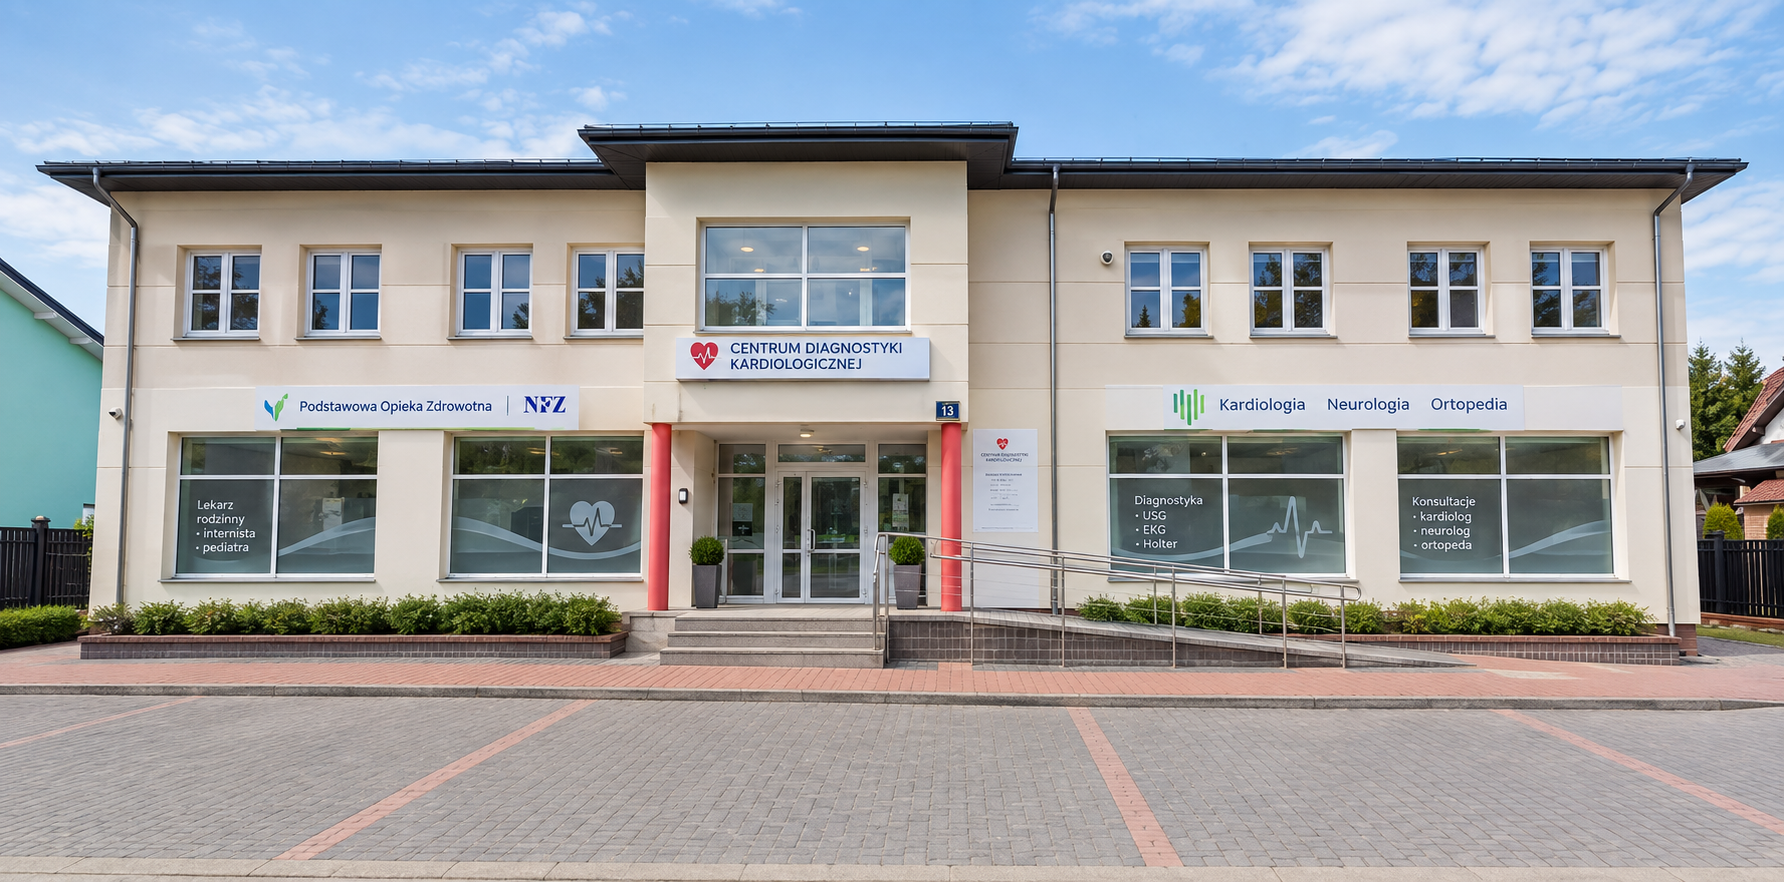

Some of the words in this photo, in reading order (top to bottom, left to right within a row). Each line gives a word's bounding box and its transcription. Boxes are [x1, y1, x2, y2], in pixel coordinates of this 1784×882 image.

[731, 342, 801, 354] CENTRUM
[806, 343, 901, 354] DIAGNOSTYKI
[731, 358, 862, 370] KARDIOLOGICZNEJ
[300, 401, 377, 411] Podstawowa
[381, 400, 422, 415] Opieka
[426, 400, 491, 411] Zdrowotna
[524, 396, 566, 413] NFZ
[1220, 398, 1305, 414] Kardiologia
[1328, 398, 1409, 414] Neurologia
[1431, 398, 1507, 413] Ortopedia
[942, 405, 954, 417] 13
[198, 500, 233, 509] Lekarz
[1135, 495, 1202, 507] Diagnostyka
[1413, 496, 1475, 508] Konsultacje
[197, 514, 245, 525] rodzinny
[1143, 511, 1166, 520] USG
[1421, 511, 1471, 524] kardiolog
[204, 528, 255, 538] internista
[1144, 525, 1165, 534] EKG
[1421, 526, 1470, 538] neurolog
[203, 542, 248, 554] pediatra
[1144, 539, 1177, 548] Holter
[1421, 540, 1472, 552] ortopeda
